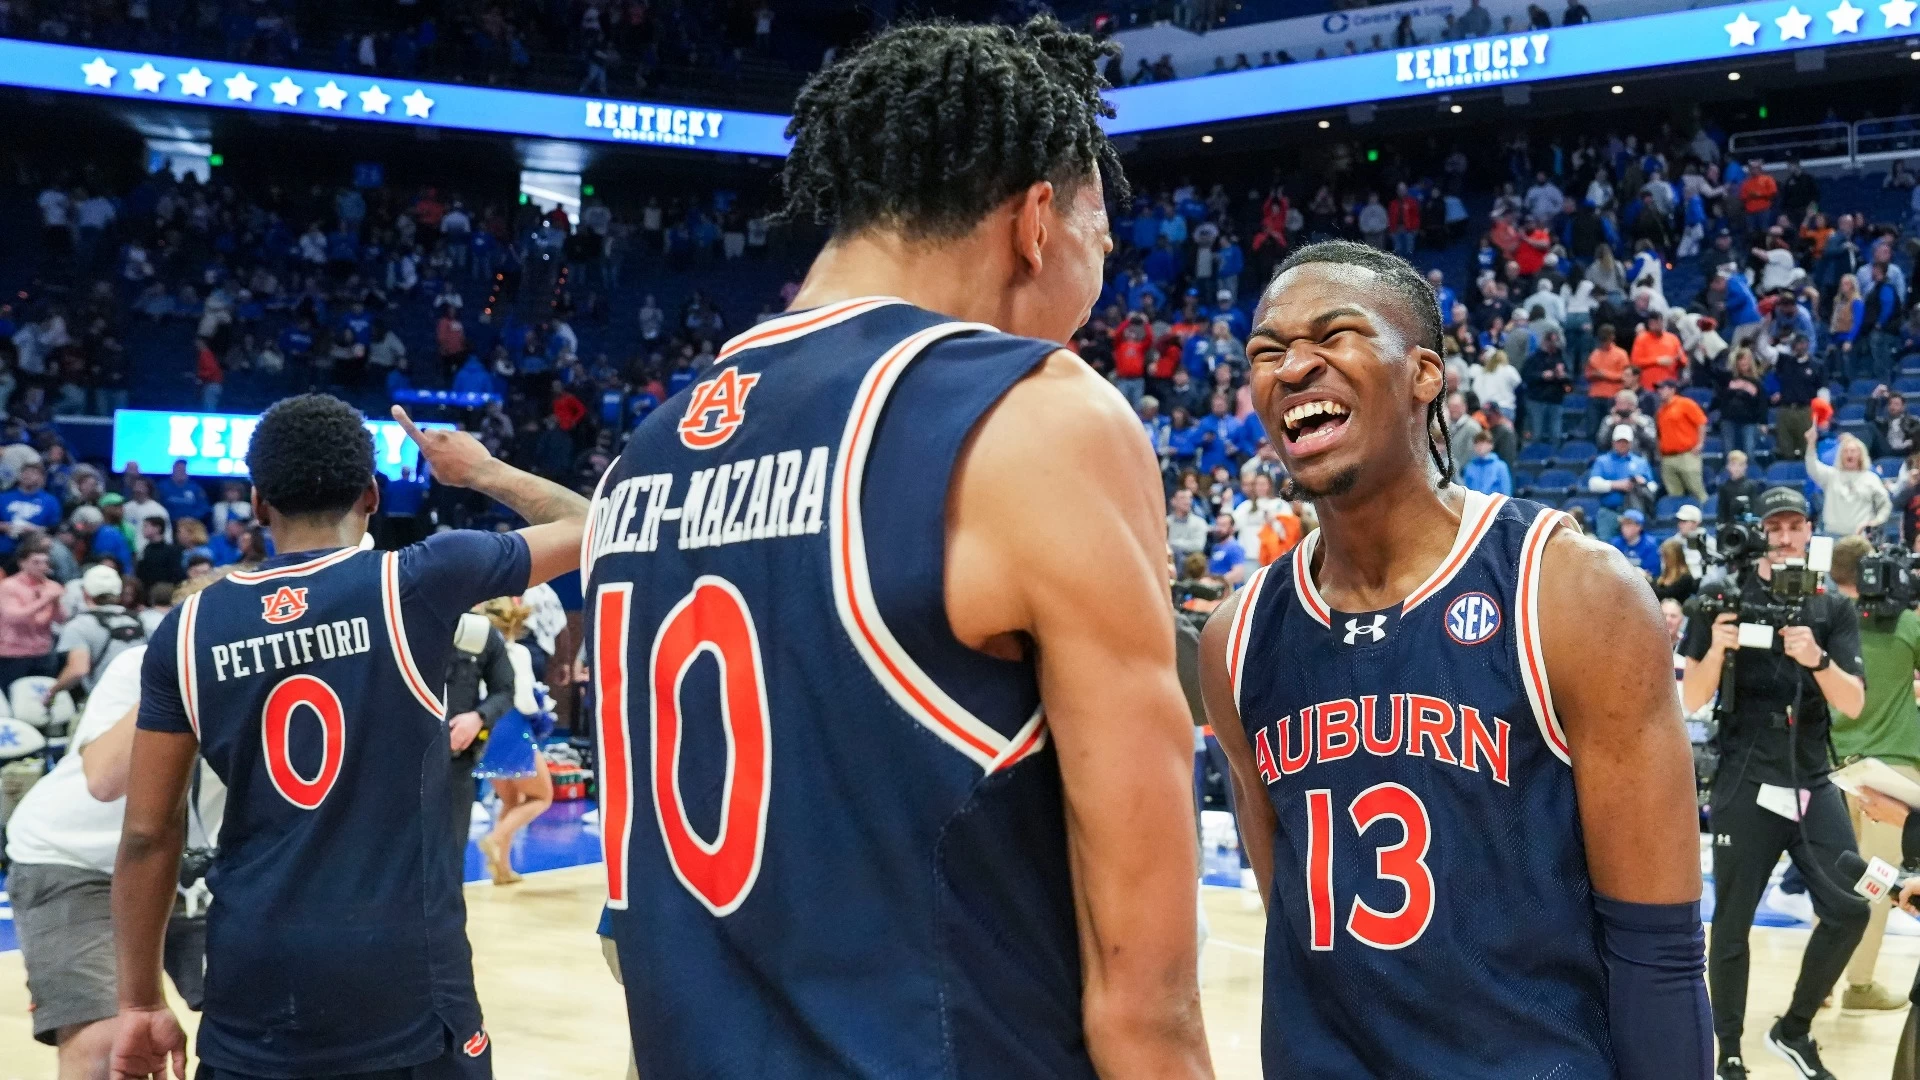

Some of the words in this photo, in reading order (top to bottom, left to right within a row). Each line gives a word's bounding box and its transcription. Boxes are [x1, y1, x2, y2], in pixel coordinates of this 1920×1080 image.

[1396, 33, 1549, 81] KENTUCKY
[585, 101, 723, 138] KENTUCKY
[211, 616, 371, 681] PETTIFORD
[1450, 596, 1494, 640] SEC
[261, 673, 346, 810] 0
[594, 575, 772, 917] 10
[1255, 693, 1510, 787] AUBURN
[1305, 781, 1436, 951] 13
